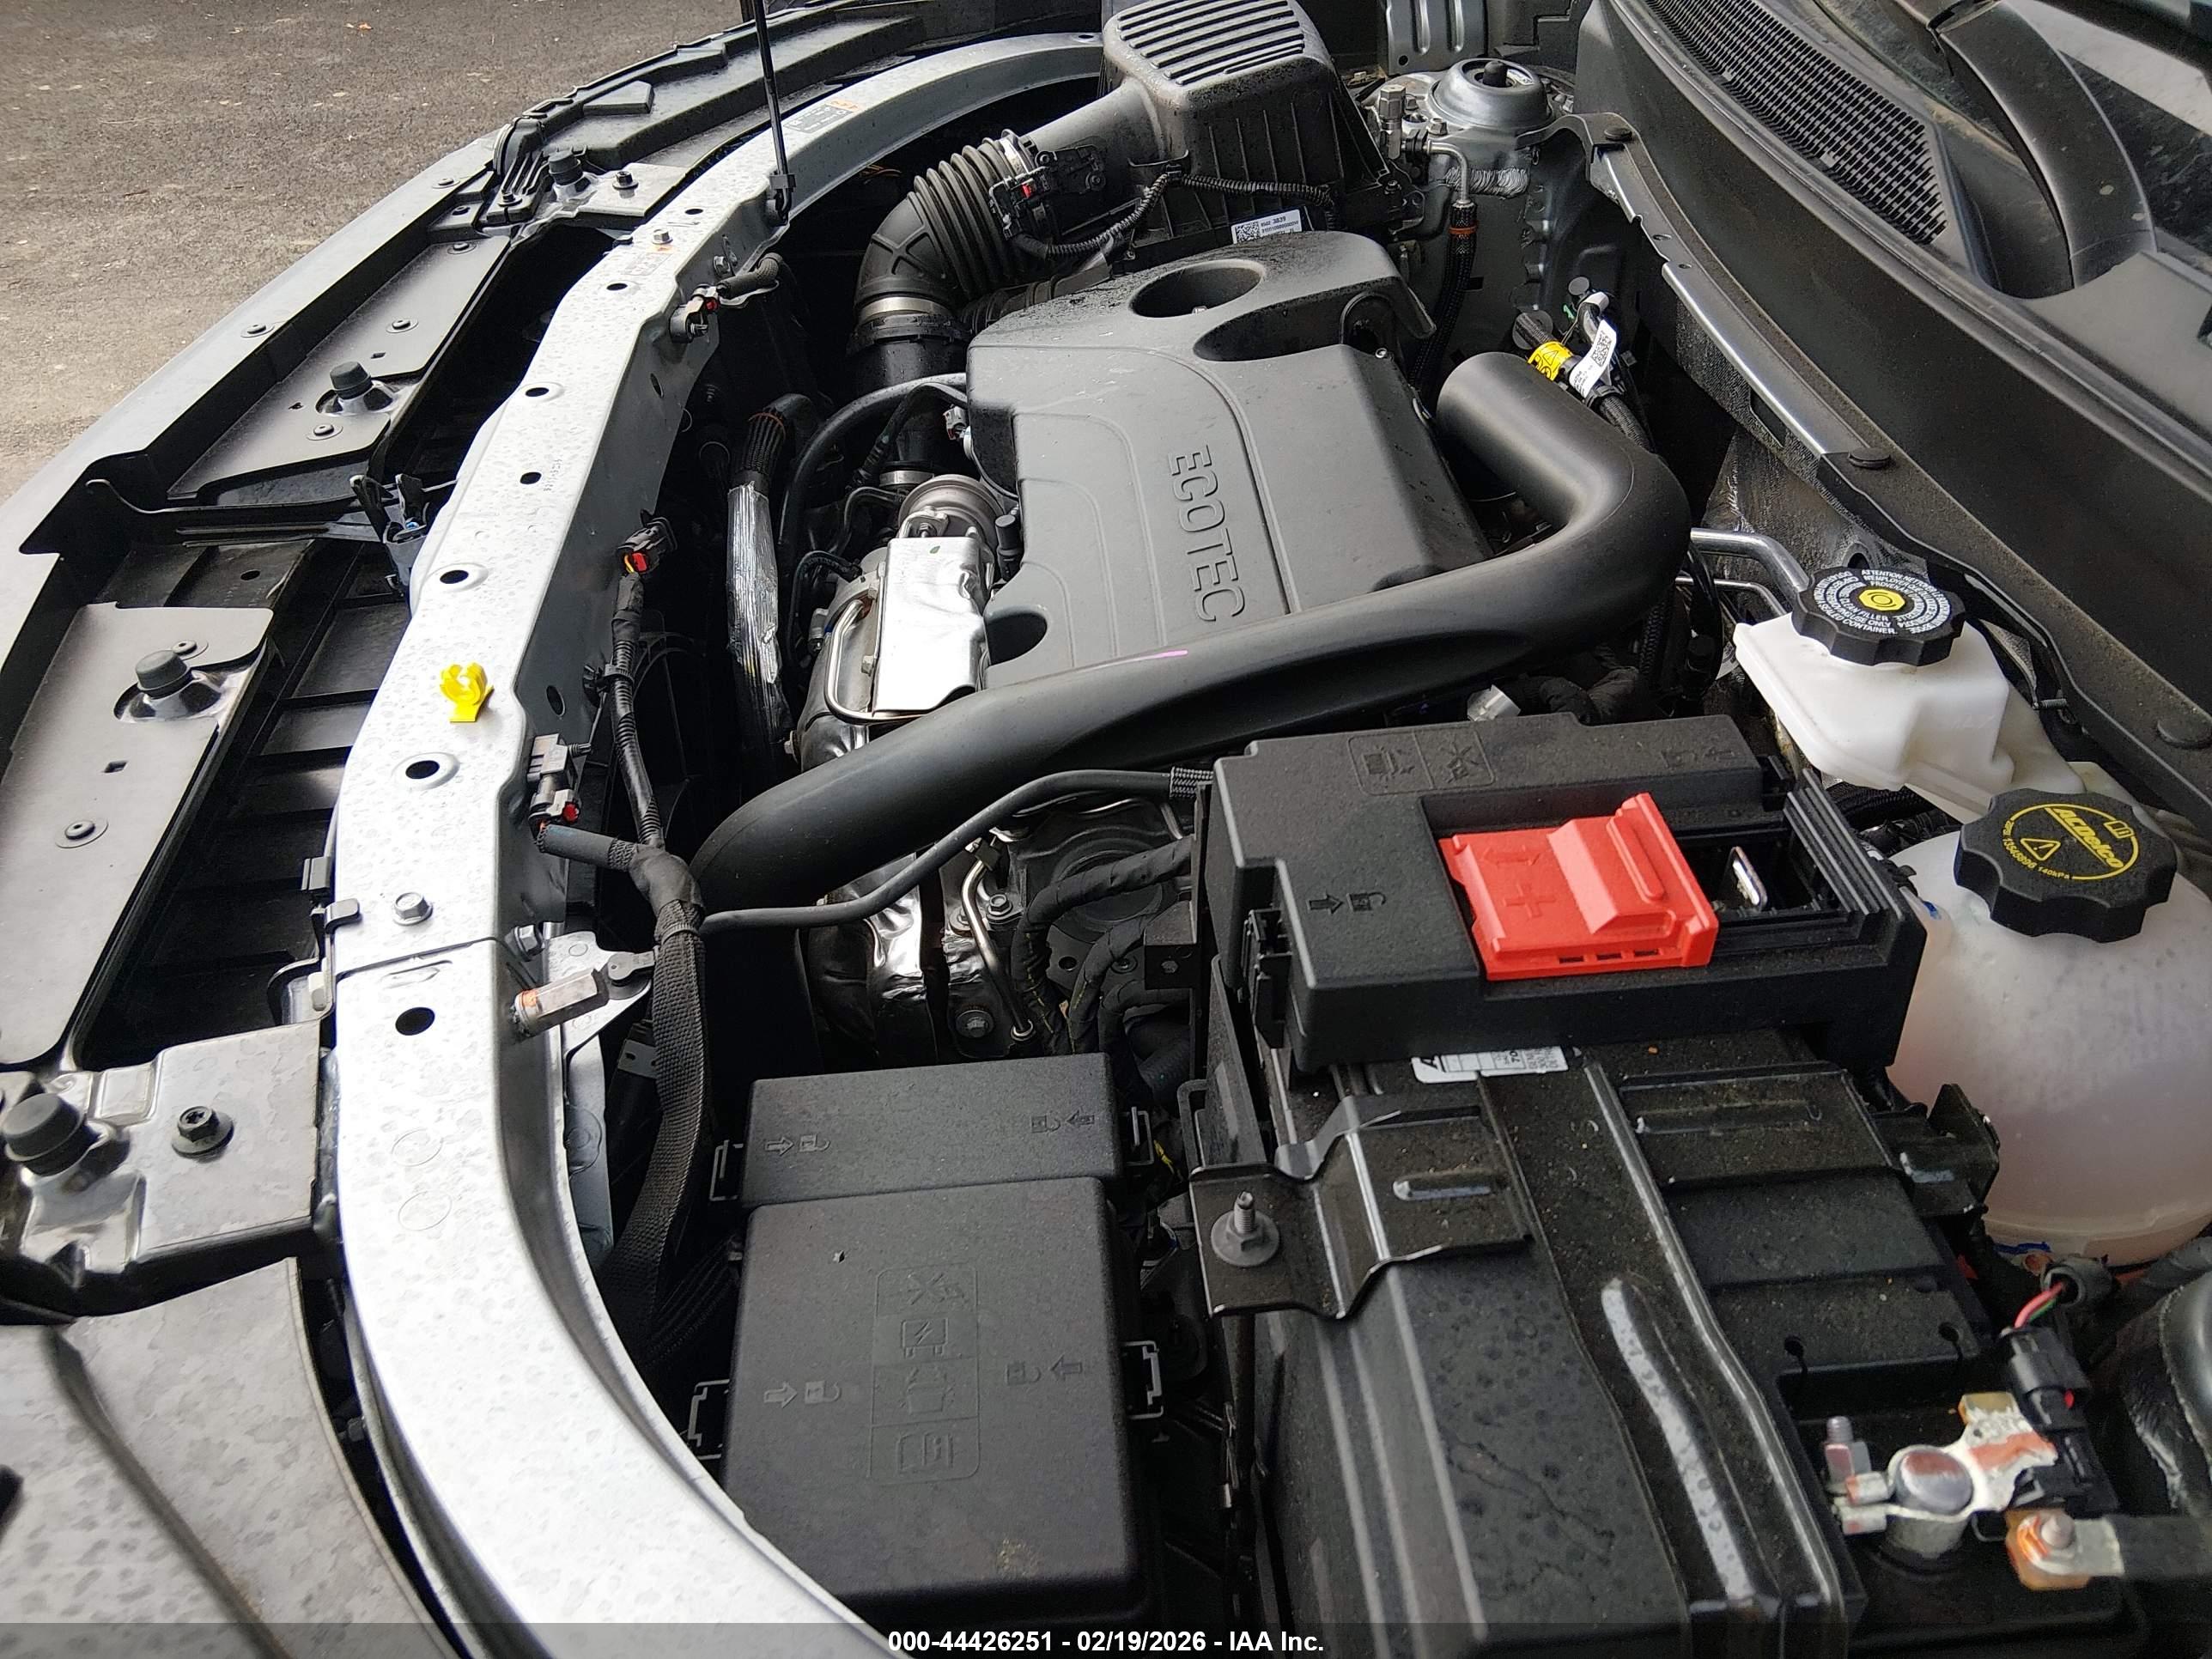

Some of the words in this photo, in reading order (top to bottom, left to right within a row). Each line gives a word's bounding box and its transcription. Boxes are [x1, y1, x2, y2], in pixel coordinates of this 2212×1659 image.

[1168, 444, 1245, 622] ECOTEC
[1817, 604, 1845, 621] SEALED
[1839, 617, 1898, 634] CONTAINER.
[1846, 614, 1867, 623] USE
[1856, 611, 1889, 621] FILLER
